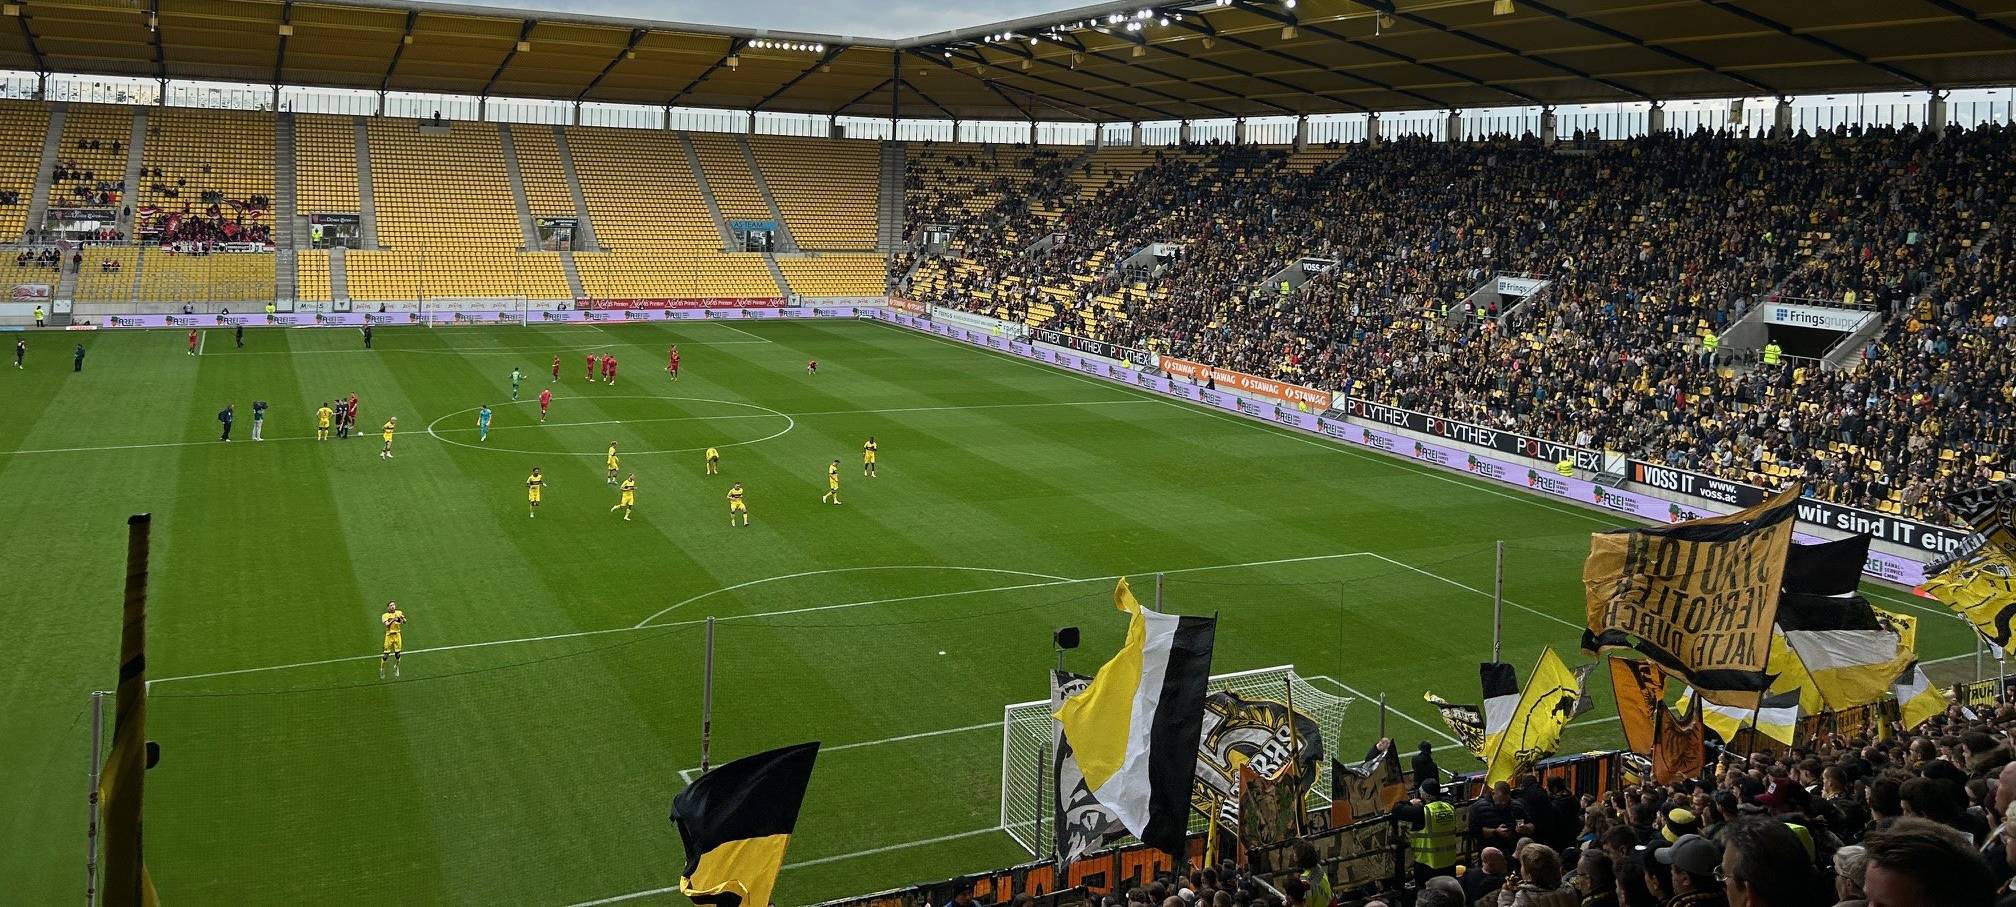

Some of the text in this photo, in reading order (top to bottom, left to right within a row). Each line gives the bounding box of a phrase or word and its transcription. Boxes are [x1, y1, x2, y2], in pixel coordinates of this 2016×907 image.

[1029, 329, 1060, 344] POLYTHEX
[1068, 338, 1102, 354] POLYTHEX
[1110, 347, 1148, 365] POLYTHEX
[1250, 381, 1279, 394] STAWAG
[1294, 391, 1326, 405] STAWAG
[1348, 400, 1409, 427] POLYTHEX
[1323, 422, 1336, 436] AREI
[1426, 418, 1498, 448] POLYTHEX
[1370, 434, 1384, 448] AREI
[1422, 448, 1437, 462] AREI
[1517, 438, 1599, 471] POLYTHEX
[1477, 461, 1493, 476] AREI
[1537, 476, 1555, 492] AREI
[1643, 466, 1695, 493] VOSS IT
[1708, 480, 1737, 493] www.
[1604, 493, 1624, 510] AREI
[1699, 488, 1737, 504] voss.ac
[1797, 504, 1831, 525] wir
[1836, 512, 1884, 538] sind
[1893, 522, 1915, 544] IT
